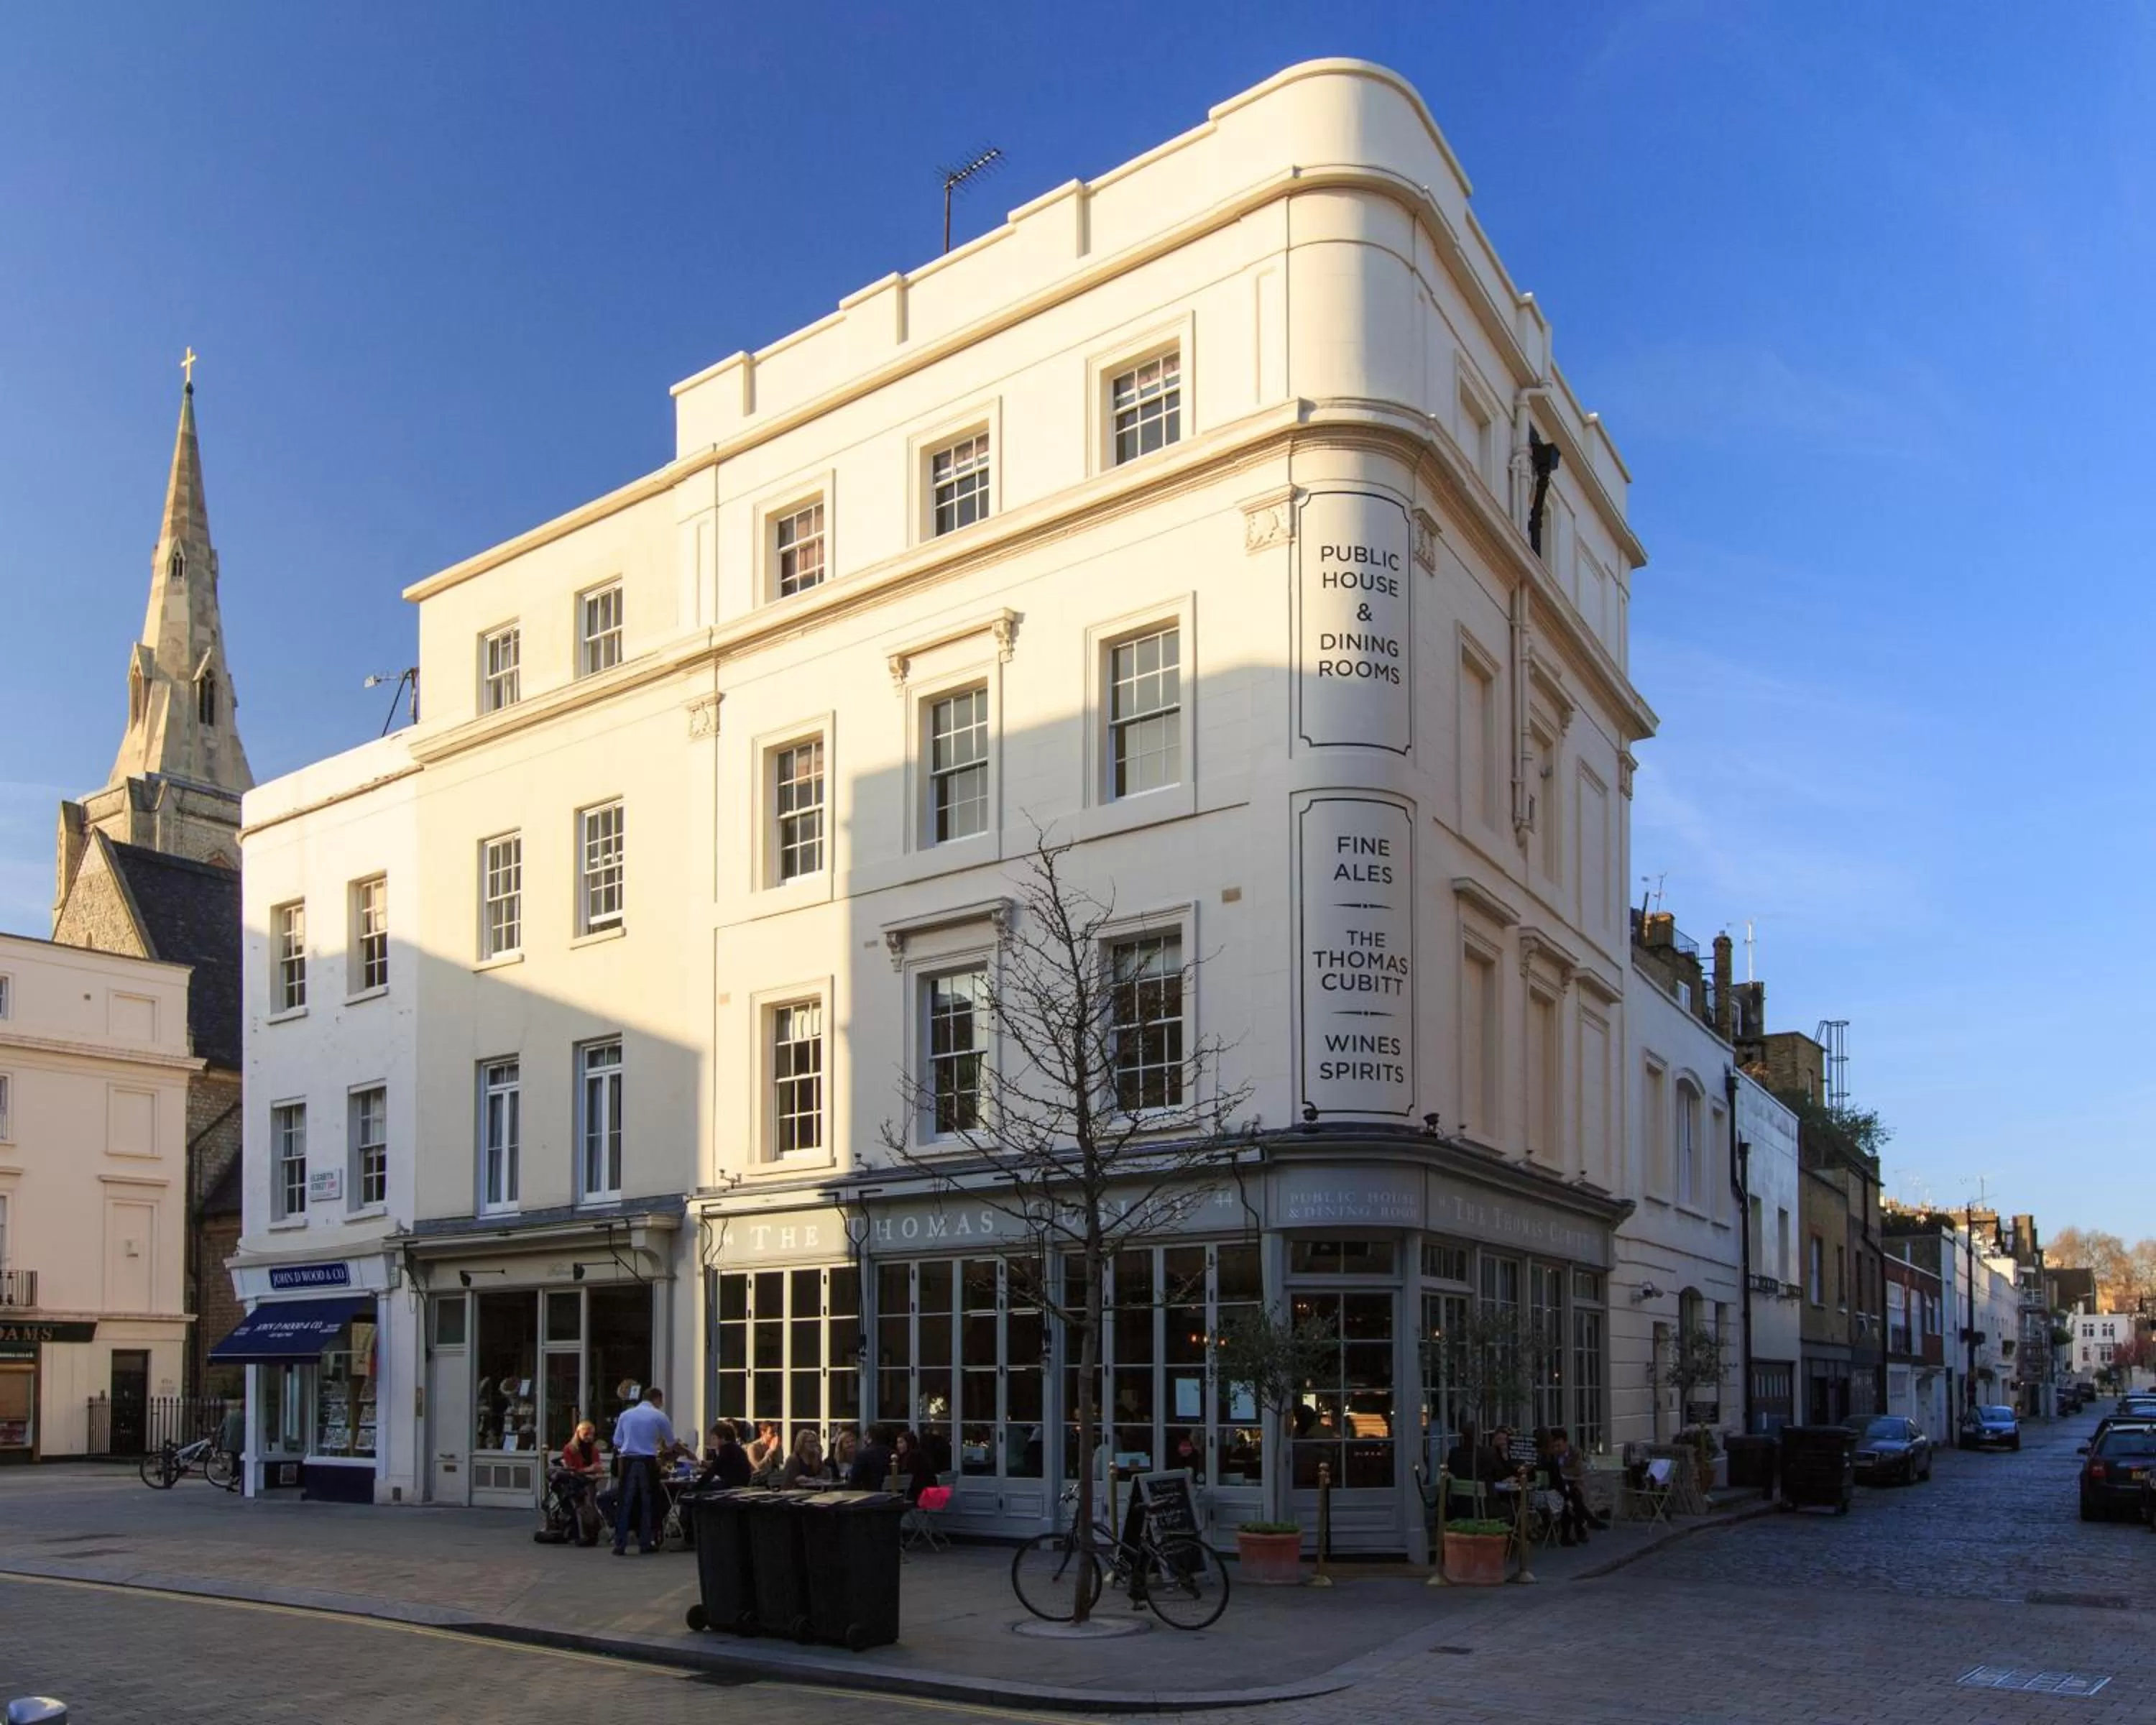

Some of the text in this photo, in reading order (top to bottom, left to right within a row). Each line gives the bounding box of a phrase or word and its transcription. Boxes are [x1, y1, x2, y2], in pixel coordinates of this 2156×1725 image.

[1320, 545, 1400, 571] PUBLIC
[1322, 571, 1399, 597] HOUSE
[1357, 603, 1373, 622] &
[1320, 633, 1399, 658] DINING
[1319, 661, 1400, 685] ROOMS
[1337, 836, 1391, 856] FINE
[1333, 864, 1392, 884] ALES
[1346, 930, 1386, 947] THE
[1313, 950, 1408, 975] THOMAS
[1322, 973, 1404, 995] CUBITT
[1325, 1035, 1401, 1055] WINES
[1319, 1062, 1404, 1083] SPIRITS
[1289, 1190, 1415, 1205] PUBLIC HOUSE
[1288, 1207, 1299, 1219] &
[1304, 1205, 1370, 1218] DINING
[750, 1224, 819, 1250] THE
[846, 1210, 994, 1242] THOMAS
[301, 1269, 325, 1282] WOOD
